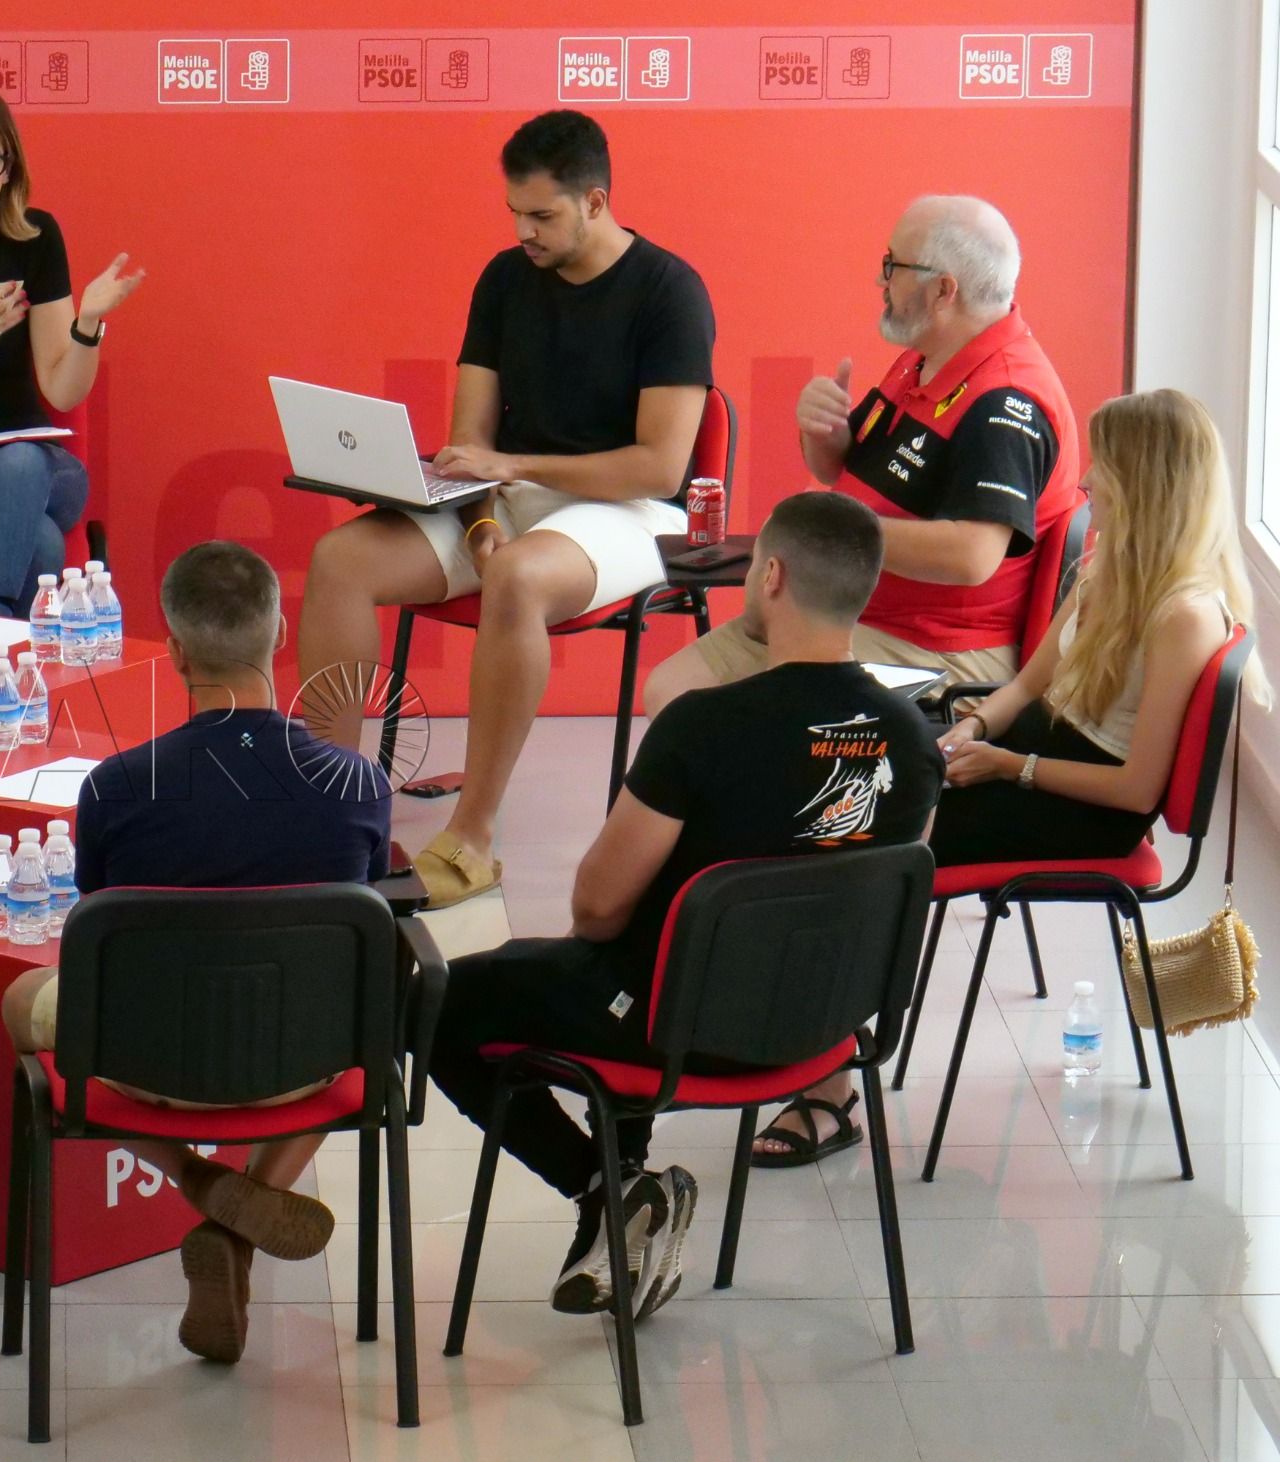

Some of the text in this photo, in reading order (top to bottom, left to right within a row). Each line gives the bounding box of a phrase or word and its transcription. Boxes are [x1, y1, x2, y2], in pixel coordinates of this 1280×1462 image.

[164, 56, 210, 69] Melilla
[364, 55, 409, 67] Melilla
[565, 53, 610, 66] Melilla
[765, 52, 810, 65] Melilla
[966, 50, 1011, 63] Melilla
[164, 70, 217, 89] PSOE
[364, 69, 417, 88] PSOE
[565, 67, 617, 87] PSOE
[765, 66, 818, 86] PSOE
[966, 65, 1019, 84] PSOE
[1004, 396, 1033, 415] aws
[810, 741, 888, 758] VALHALLA
